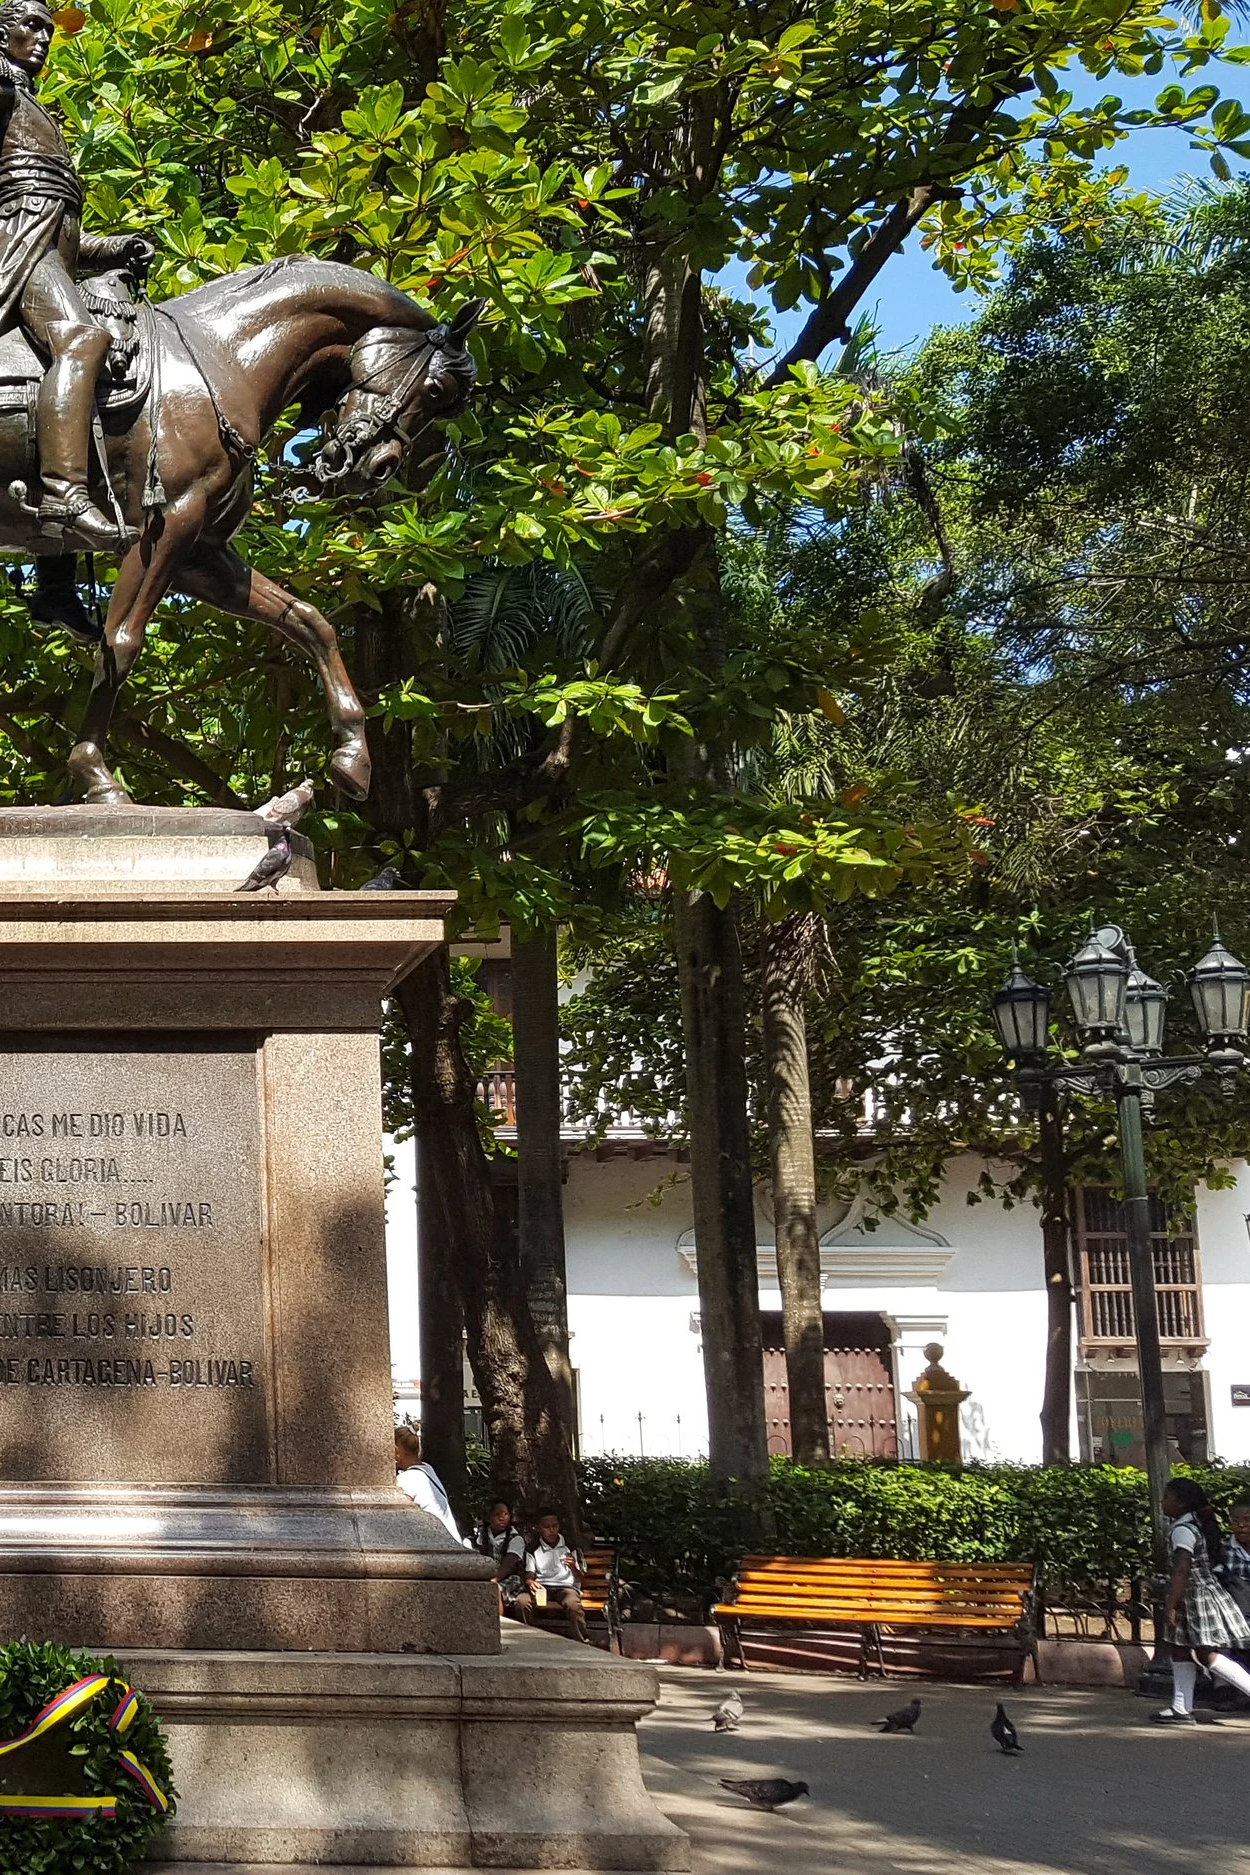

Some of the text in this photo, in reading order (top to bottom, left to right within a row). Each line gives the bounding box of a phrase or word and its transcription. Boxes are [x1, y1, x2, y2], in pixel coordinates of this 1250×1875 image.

[52, 1113, 83, 1138] ME
[133, 1112, 187, 1138] VIDA
[46, 1266, 171, 1294] LISONJERO
[72, 1313, 116, 1339] LOS
[125, 1313, 194, 1339] HIJOS
